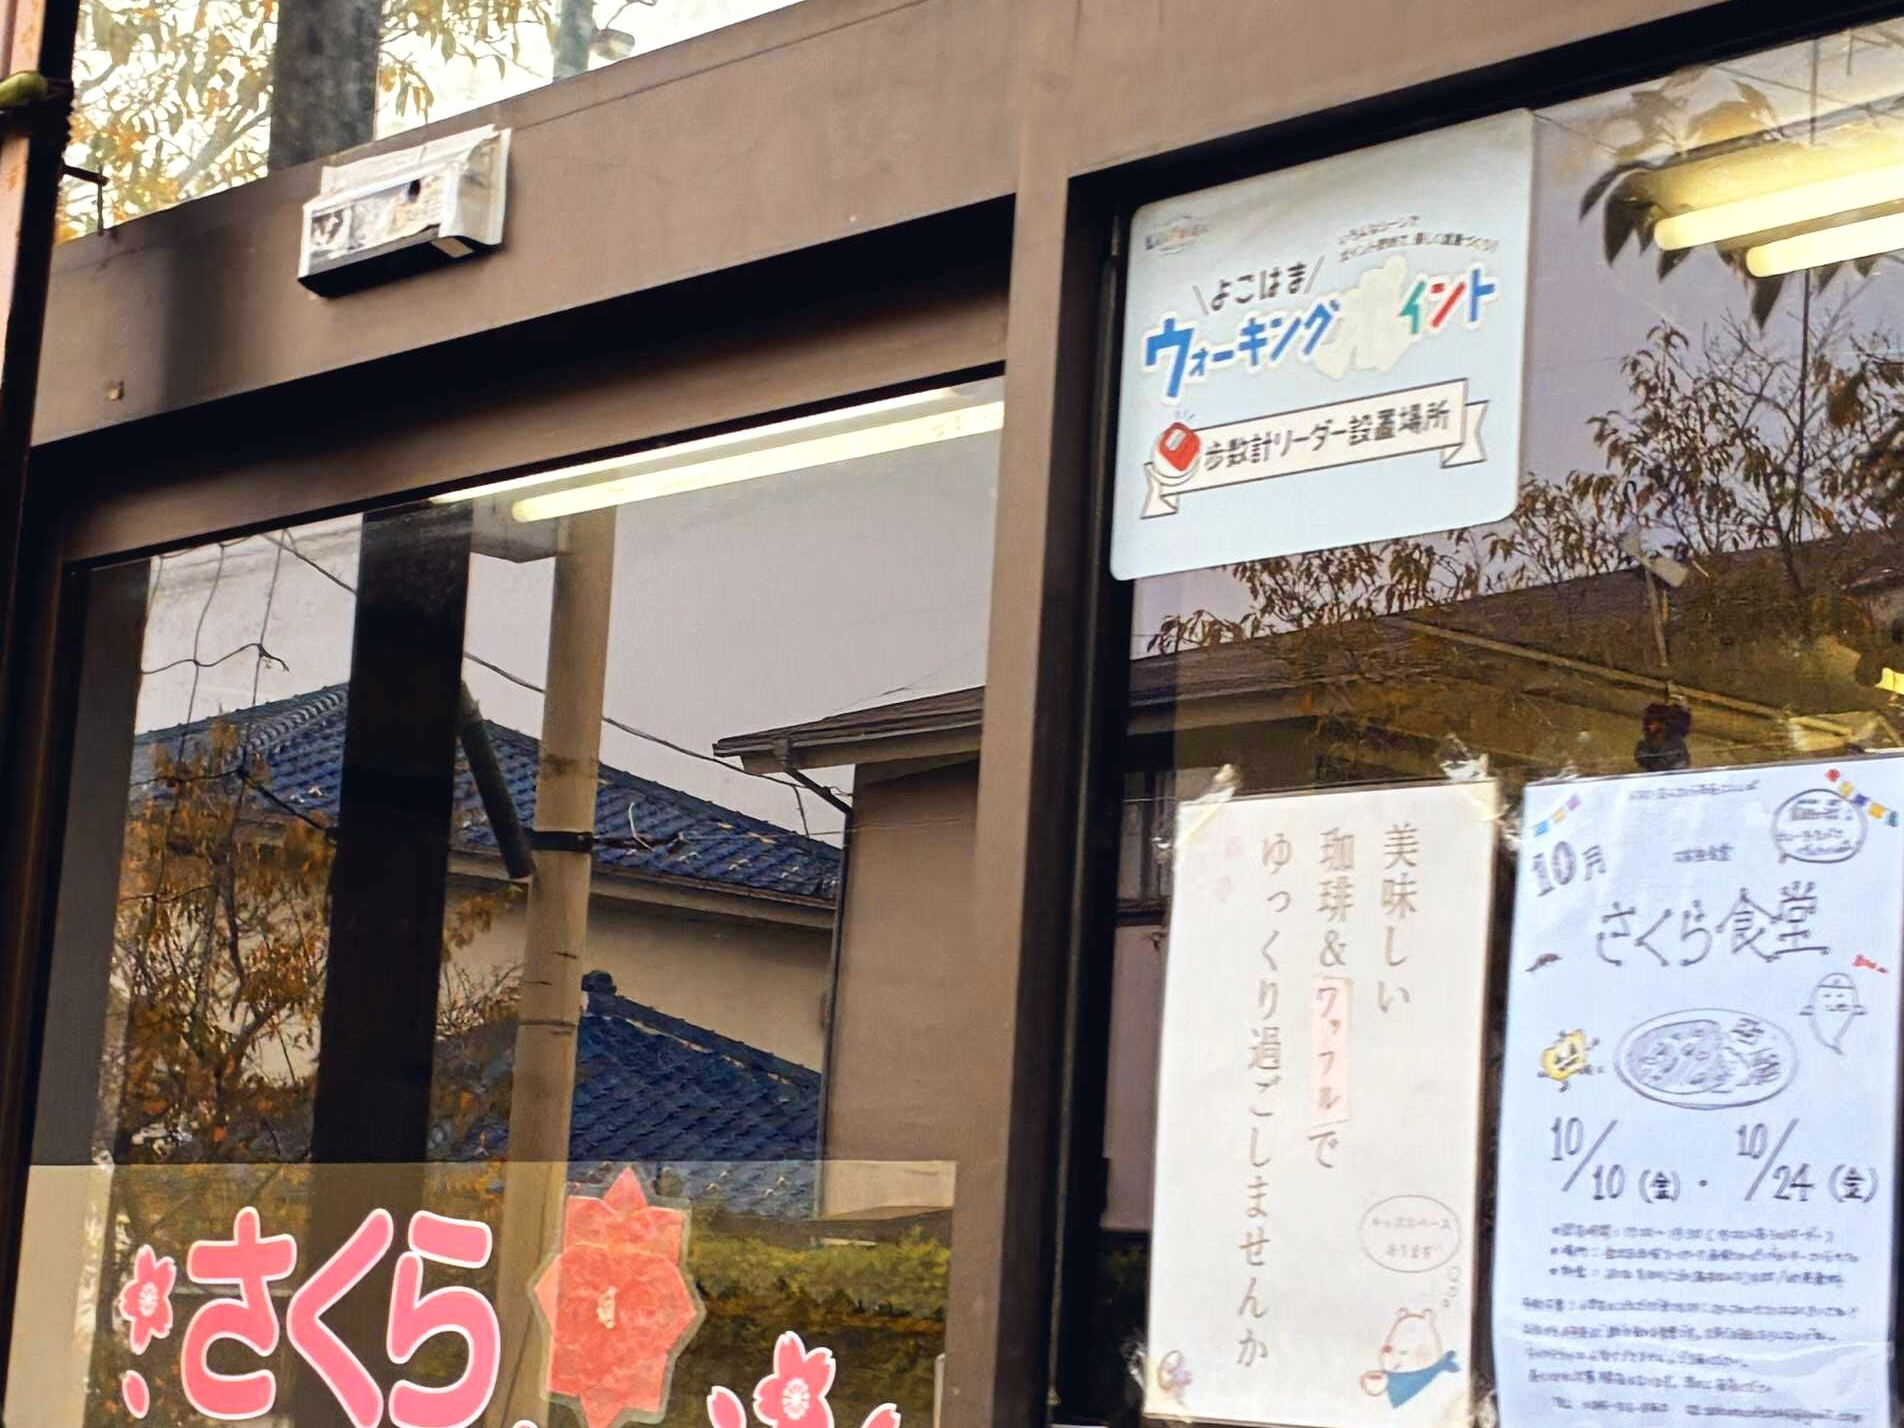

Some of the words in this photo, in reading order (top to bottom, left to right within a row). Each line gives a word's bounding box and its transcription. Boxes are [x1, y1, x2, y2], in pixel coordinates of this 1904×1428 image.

[1145, 267, 1497, 399] ウォーキングイント
[1209, 261, 1308, 312] よこはま
[1204, 400, 1450, 471] 歩数計リーダー設置場所
[1377, 822, 1420, 1014] 美味しい
[1595, 881, 1831, 967] さくら食堂
[1235, 832, 1293, 1368] ゆっくり過ごしませんか
